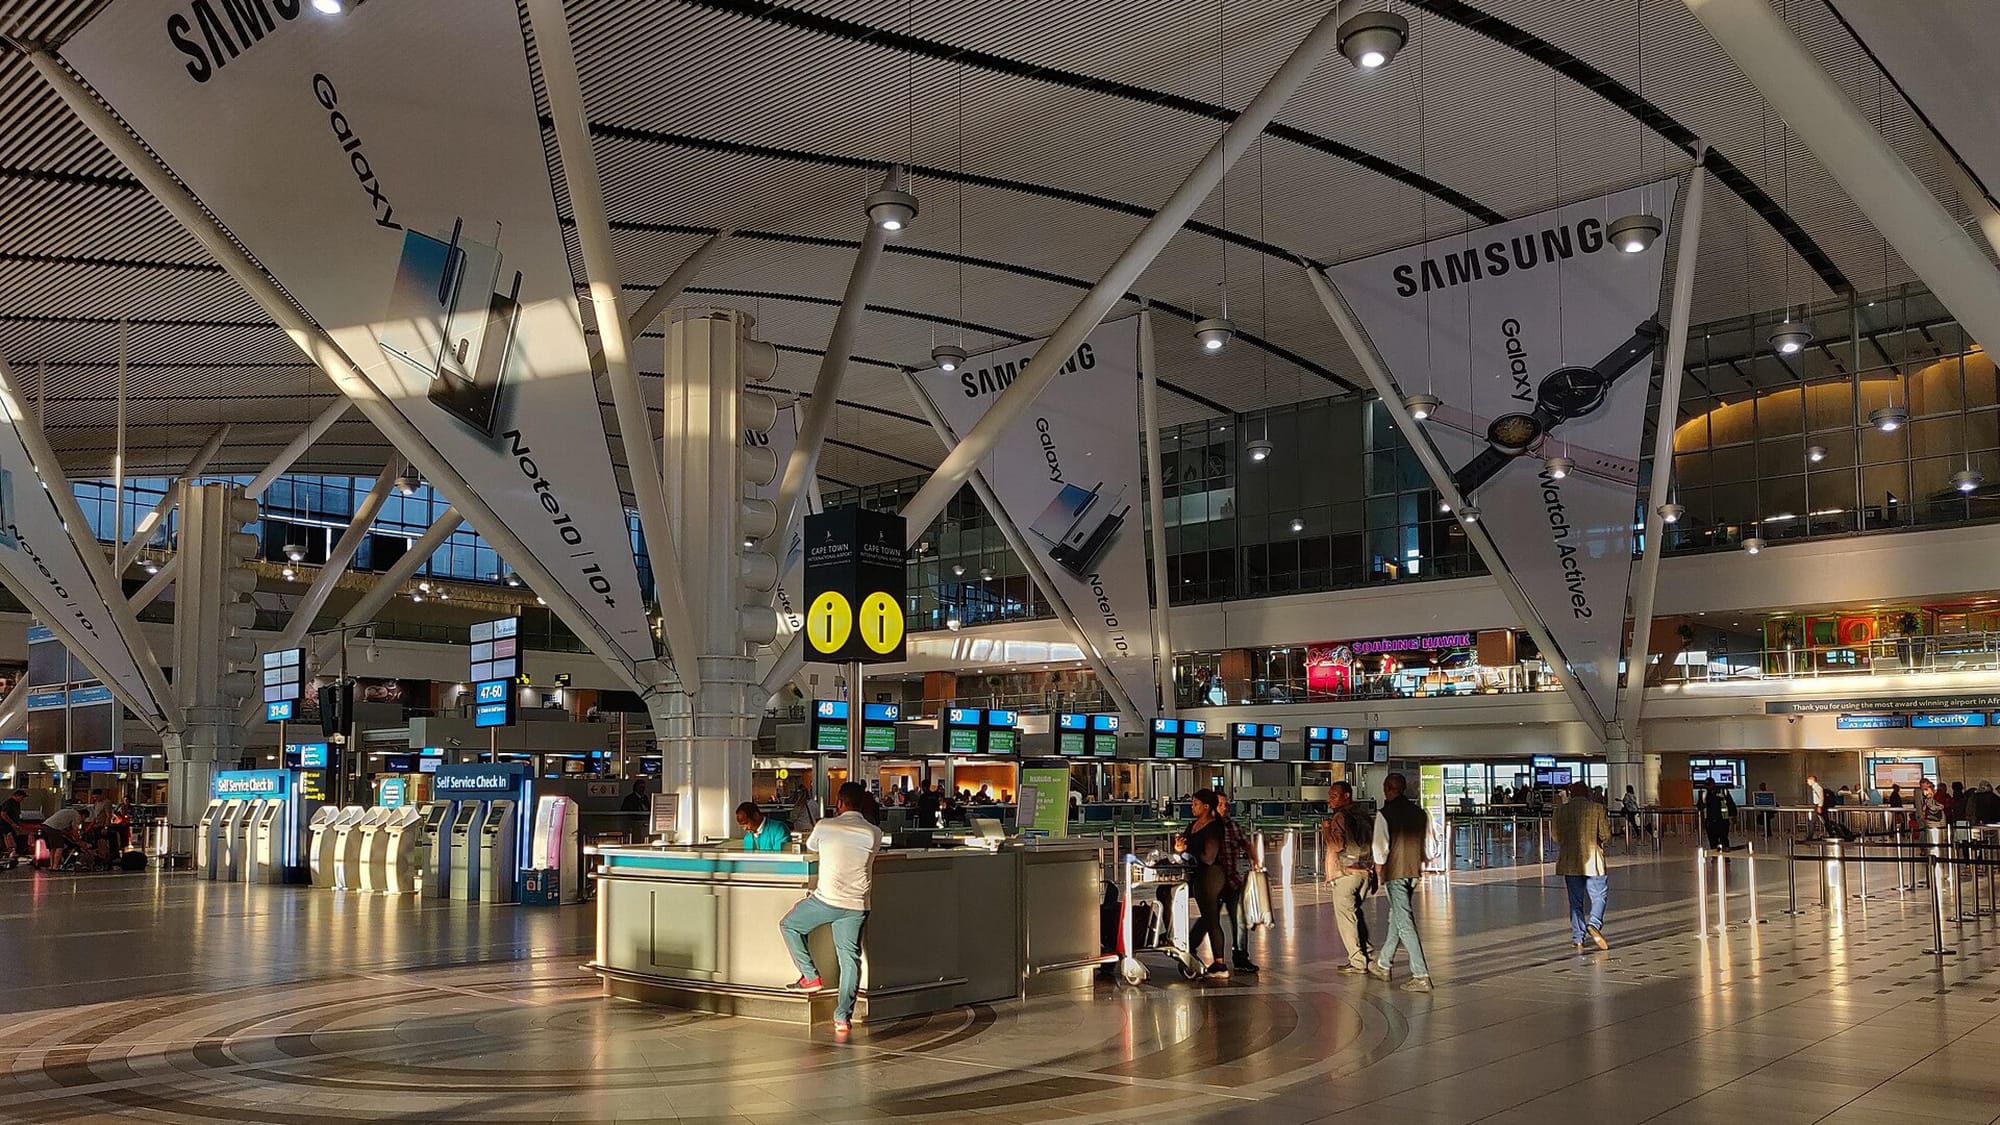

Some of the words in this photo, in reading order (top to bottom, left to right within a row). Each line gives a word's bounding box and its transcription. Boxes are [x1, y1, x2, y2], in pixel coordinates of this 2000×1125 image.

[313, 74, 403, 230] Galaxy
[1393, 218, 1604, 297] SAMSUNG
[1502, 318, 1534, 402] Galaxy
[1036, 417, 1065, 485] Galaxy
[503, 430, 582, 545] Note10
[582, 563, 616, 609] 10+
[811, 545, 827, 556] CAPE
[828, 543, 849, 553] TOWN
[863, 543, 880, 553] CAPE
[881, 546, 901, 556] TOWN
[1538, 470, 1570, 539] Watch
[1557, 544, 1593, 619] Active2
[8, 524, 69, 599] Note10
[1088, 573, 1119, 627] Note10
[1113, 636, 1128, 658] 10+
[1352, 639, 1419, 654] SOARING
[1422, 634, 1471, 650] HAWK
[818, 701, 834, 716] 48
[1793, 703, 1813, 711] Thank
[1841, 702, 1860, 710] using
[1920, 698, 1949, 708] winning
[1951, 698, 1977, 706] airport
[1979, 697, 1986, 705] in
[885, 706, 898, 718] 49
[950, 709, 962, 722] 50
[1007, 711, 1017, 724] 51
[1061, 715, 1071, 726] 52
[1108, 717, 1118, 728] 53
[1156, 719, 1165, 730] 54
[1928, 714, 1969, 725] Security
[1196, 721, 1205, 732] 55
[1237, 724, 1246, 734] 56
[1274, 725, 1282, 736] 57
[218, 778, 229, 792] Self
[229, 778, 249, 792] Service
[249, 777, 268, 791] Check
[437, 776, 450, 788] Self
[451, 776, 476, 788] Service
[476, 775, 498, 788] Check
[499, 775, 506, 787] In
